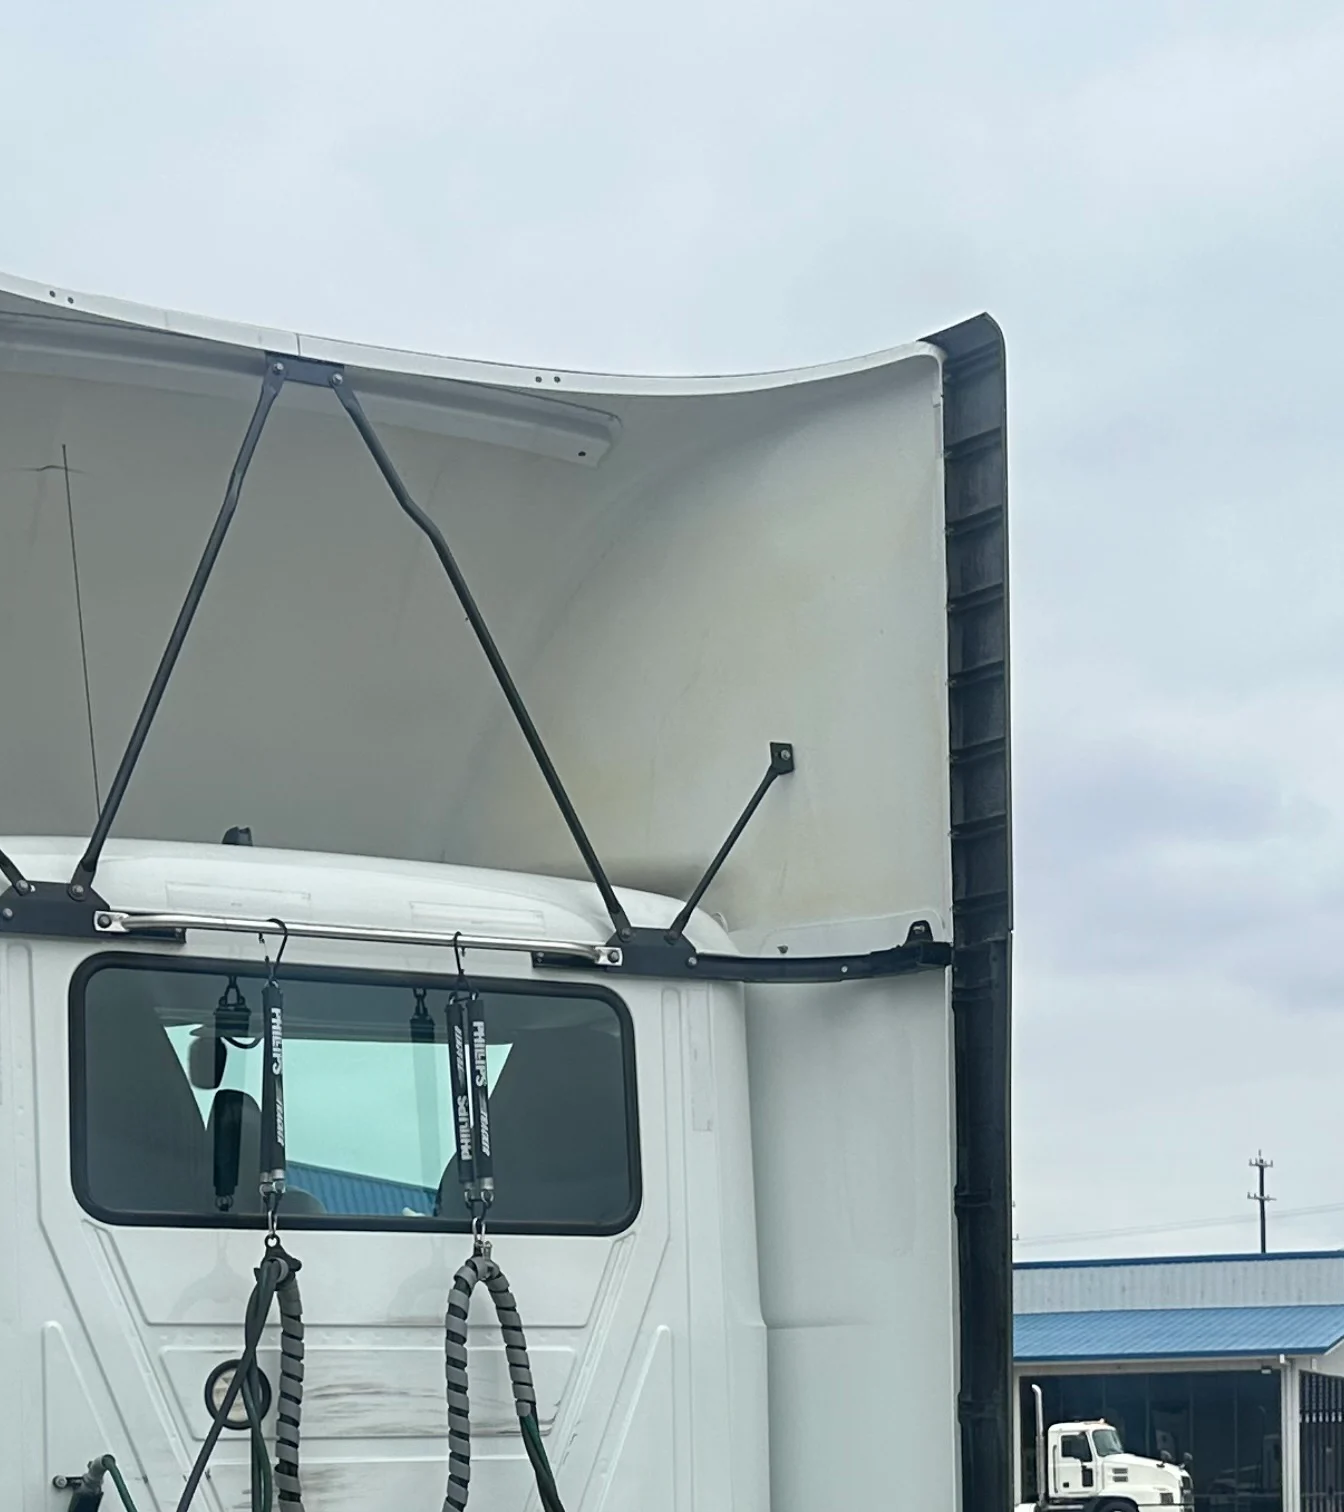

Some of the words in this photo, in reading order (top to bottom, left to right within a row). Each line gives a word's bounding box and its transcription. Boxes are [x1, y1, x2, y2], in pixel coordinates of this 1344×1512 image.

[271, 1007, 284, 1075] PHILLIPS
[473, 1020, 487, 1087] PHILLIPS
[457, 1095, 473, 1161] PHILLIPS
